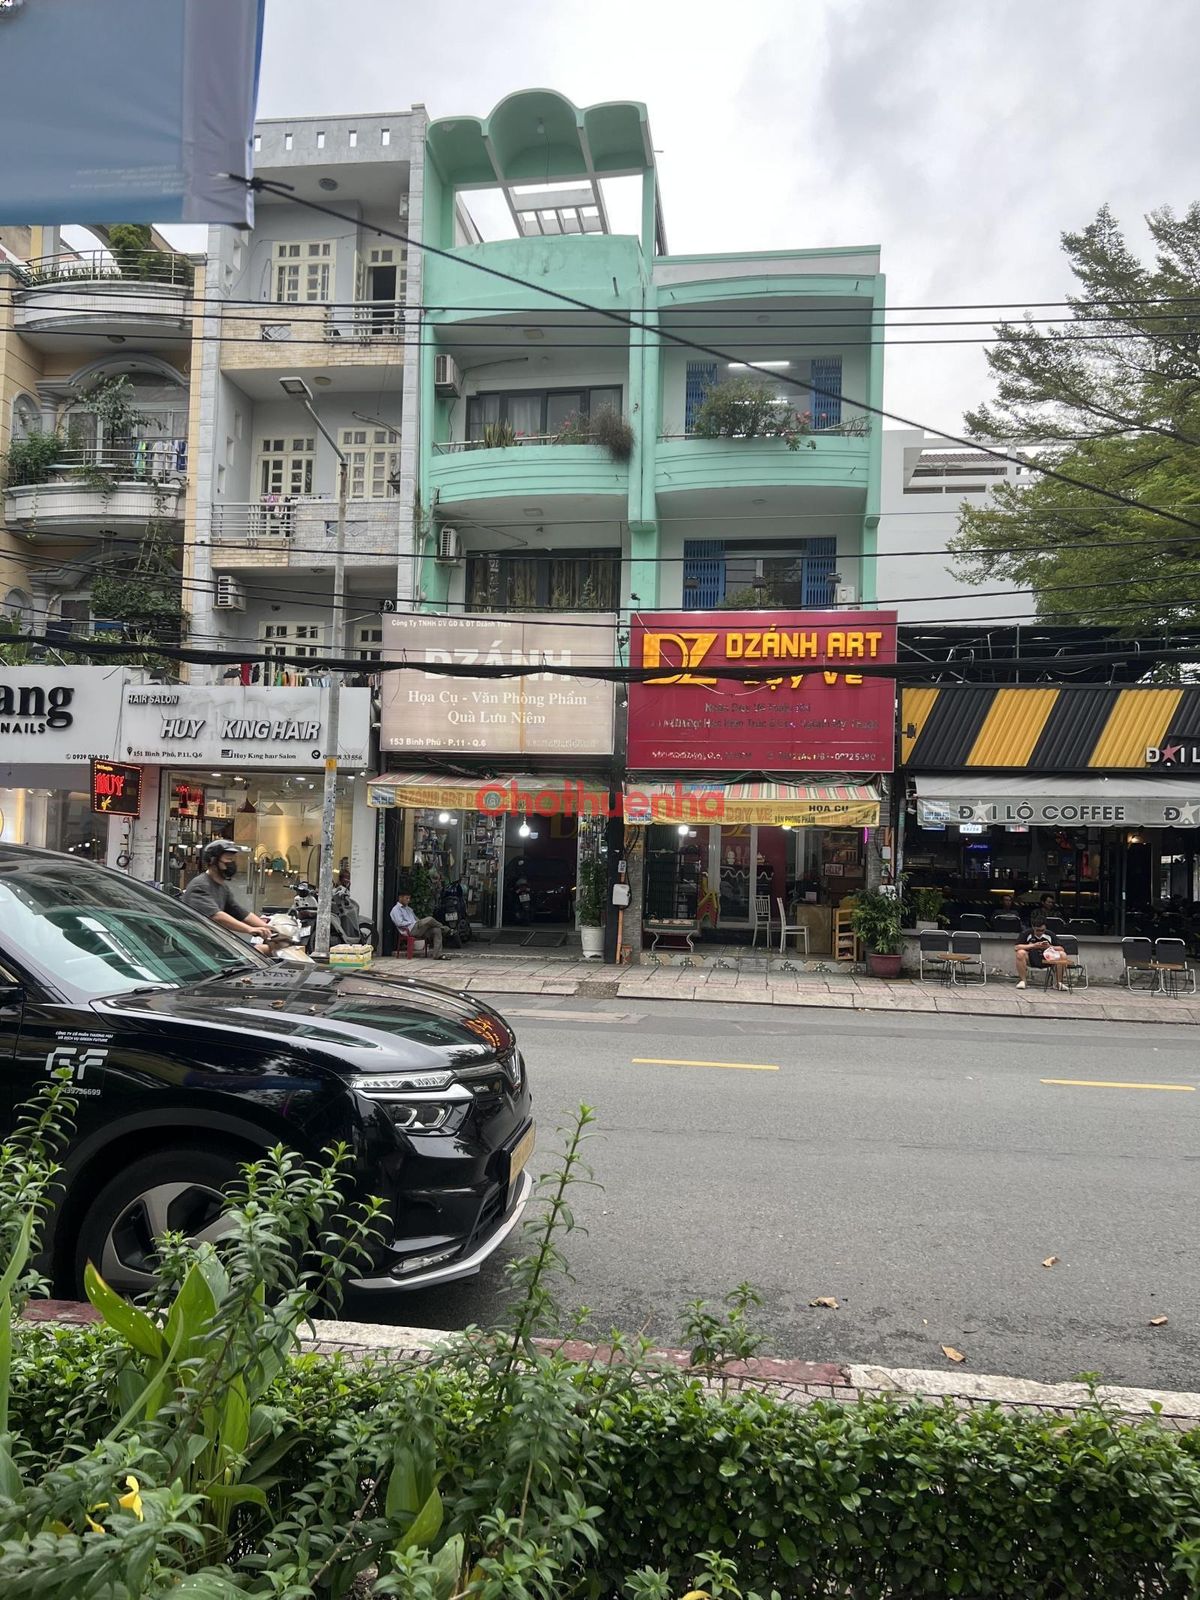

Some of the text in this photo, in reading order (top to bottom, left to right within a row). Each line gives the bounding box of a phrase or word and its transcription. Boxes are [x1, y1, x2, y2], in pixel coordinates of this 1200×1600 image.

[725, 624, 883, 659] DZÁNH ART
[128, 695, 180, 705] HAIR SALON
[407, 690, 436, 706] Họa
[438, 690, 459, 706] Cụ
[471, 690, 499, 705] Văn
[502, 691, 545, 708] Phòng
[549, 689, 588, 705] Phẩm
[447, 710, 476, 725] Quà
[479, 710, 507, 724] Lưu
[0, 722, 46, 734] NAILS
[160, 719, 322, 741] HUY KING HAIR
[389, 737, 404, 746] 153
[447, 738, 465, 747] P.11
[233, 753, 247, 761] Huy
[247, 752, 264, 761] King
[278, 752, 297, 760] Salon
[1005, 801, 1034, 824] LỘ
[1041, 804, 1125, 821] COFFEE
